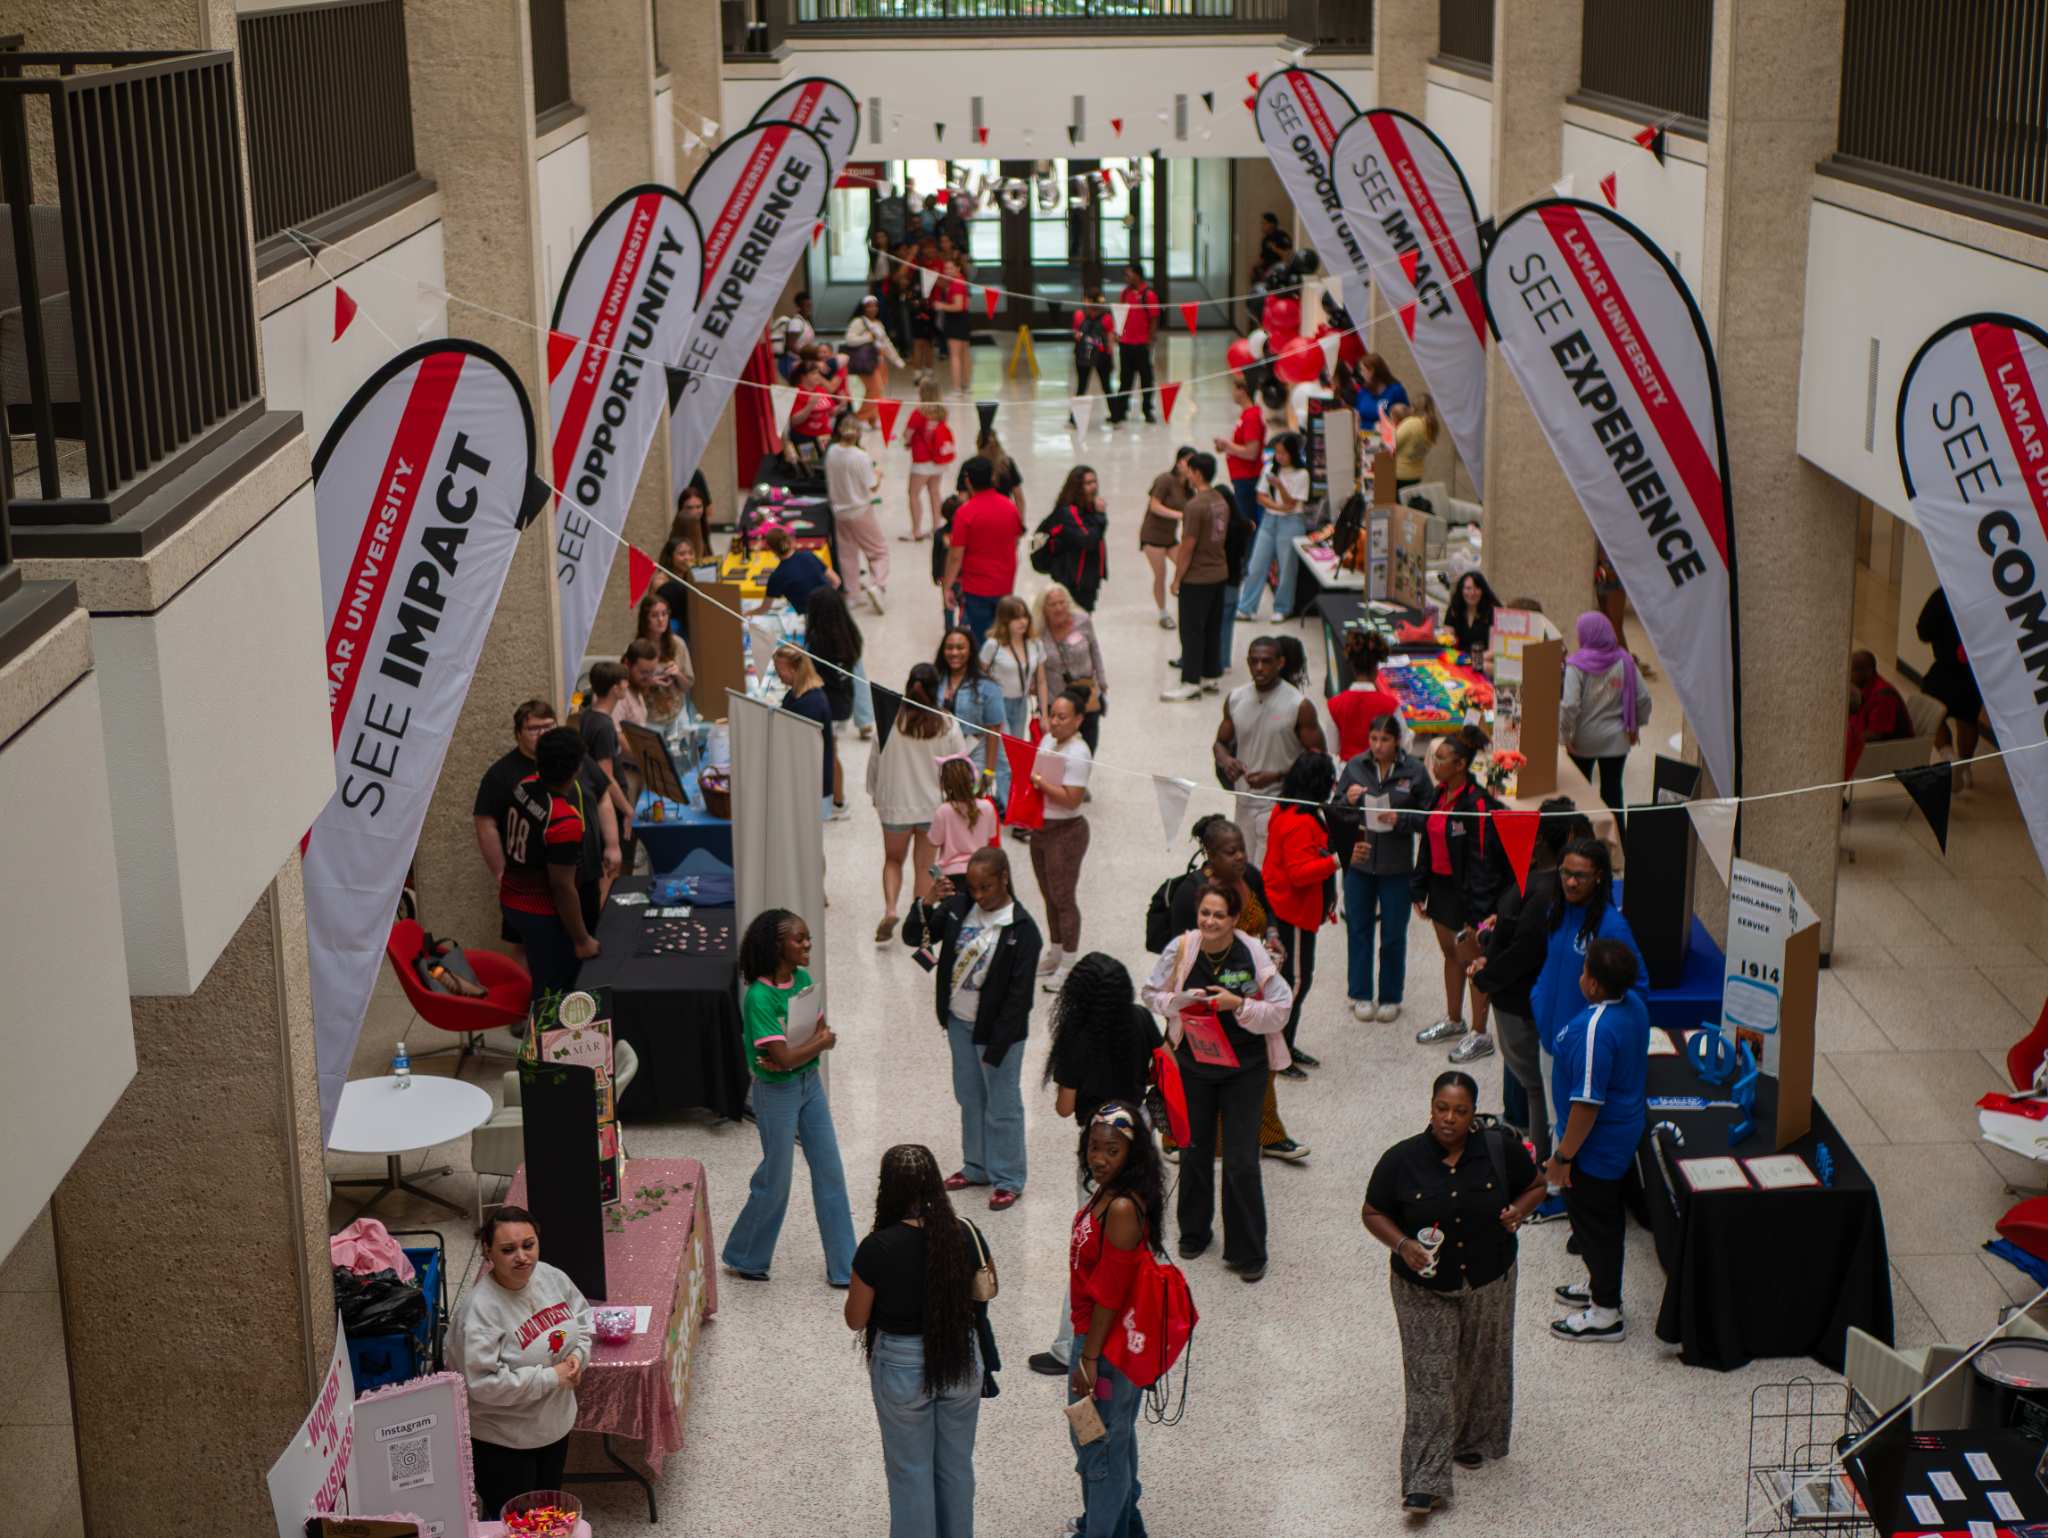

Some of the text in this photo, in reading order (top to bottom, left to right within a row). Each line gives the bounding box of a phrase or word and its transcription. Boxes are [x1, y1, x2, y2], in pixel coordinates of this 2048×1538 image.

[1269, 91, 1303, 136] SEE
[705, 143, 775, 269] LAMAR UNIVERSITY
[1353, 154, 1397, 213] SEE
[1398, 159, 1427, 206] LAMAR
[703, 155, 812, 339] EXPERIENCE
[583, 208, 651, 384] LAMAR UNIVERSITY
[1562, 228, 1669, 408] LAMAR UNIVERSITY
[557, 225, 685, 586] SEE OPPORTUNITY
[1509, 252, 1708, 589] SEE EXPERIENCE
[1932, 391, 2003, 504] SEE
[1997, 361, 2045, 463] LAMAR
[344, 456, 413, 632] UNIVERSITY
[341, 430, 491, 818] SEE IMPACT
[1731, 892, 1782, 913] SCHOLARSHIP
[1733, 873, 1784, 895] BROTHERHOOD
[1737, 916, 1770, 933] SERVICE
[1741, 958, 1780, 983] 1914
[307, 1367, 340, 1448] WOMEN
[326, 1415, 339, 1452] IN
[380, 1416, 432, 1438] Instagram
